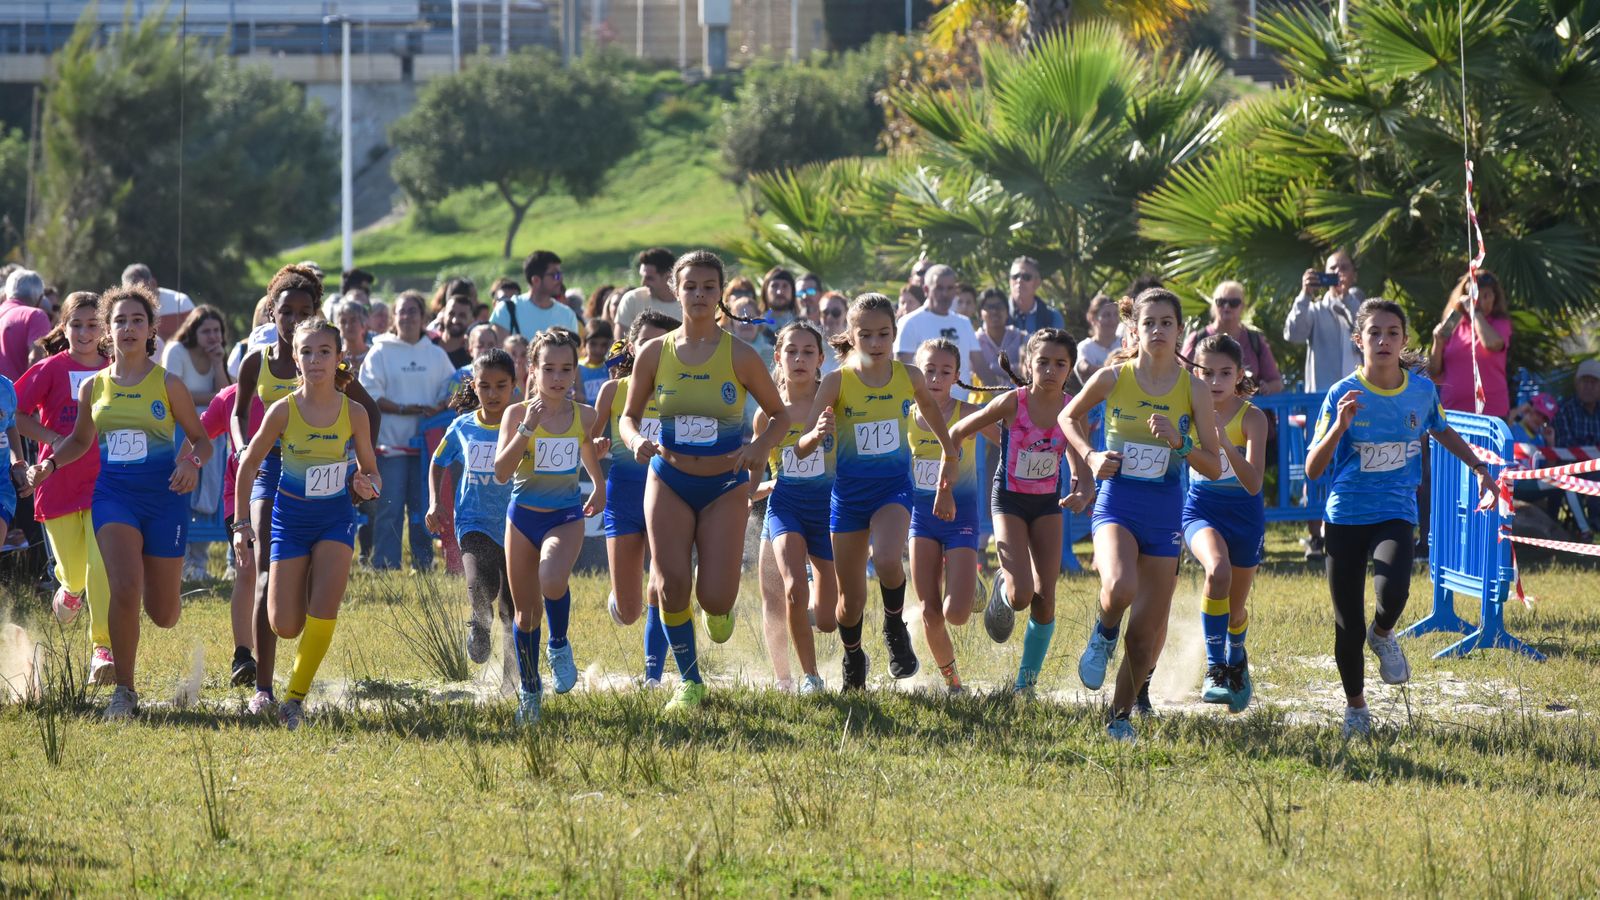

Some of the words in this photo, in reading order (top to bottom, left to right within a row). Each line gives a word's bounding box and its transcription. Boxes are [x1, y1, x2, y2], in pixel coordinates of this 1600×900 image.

[677, 416, 716, 438] 353
[859, 422, 895, 451] 213
[110, 432, 144, 456] 255
[470, 444, 499, 468] 27
[537, 441, 574, 468] 269
[1364, 444, 1404, 469] 252
[784, 449, 820, 473] 267
[1026, 458, 1054, 477] 148
[1127, 446, 1167, 472] 354
[310, 465, 341, 492] 211
[916, 461, 941, 486] 26
